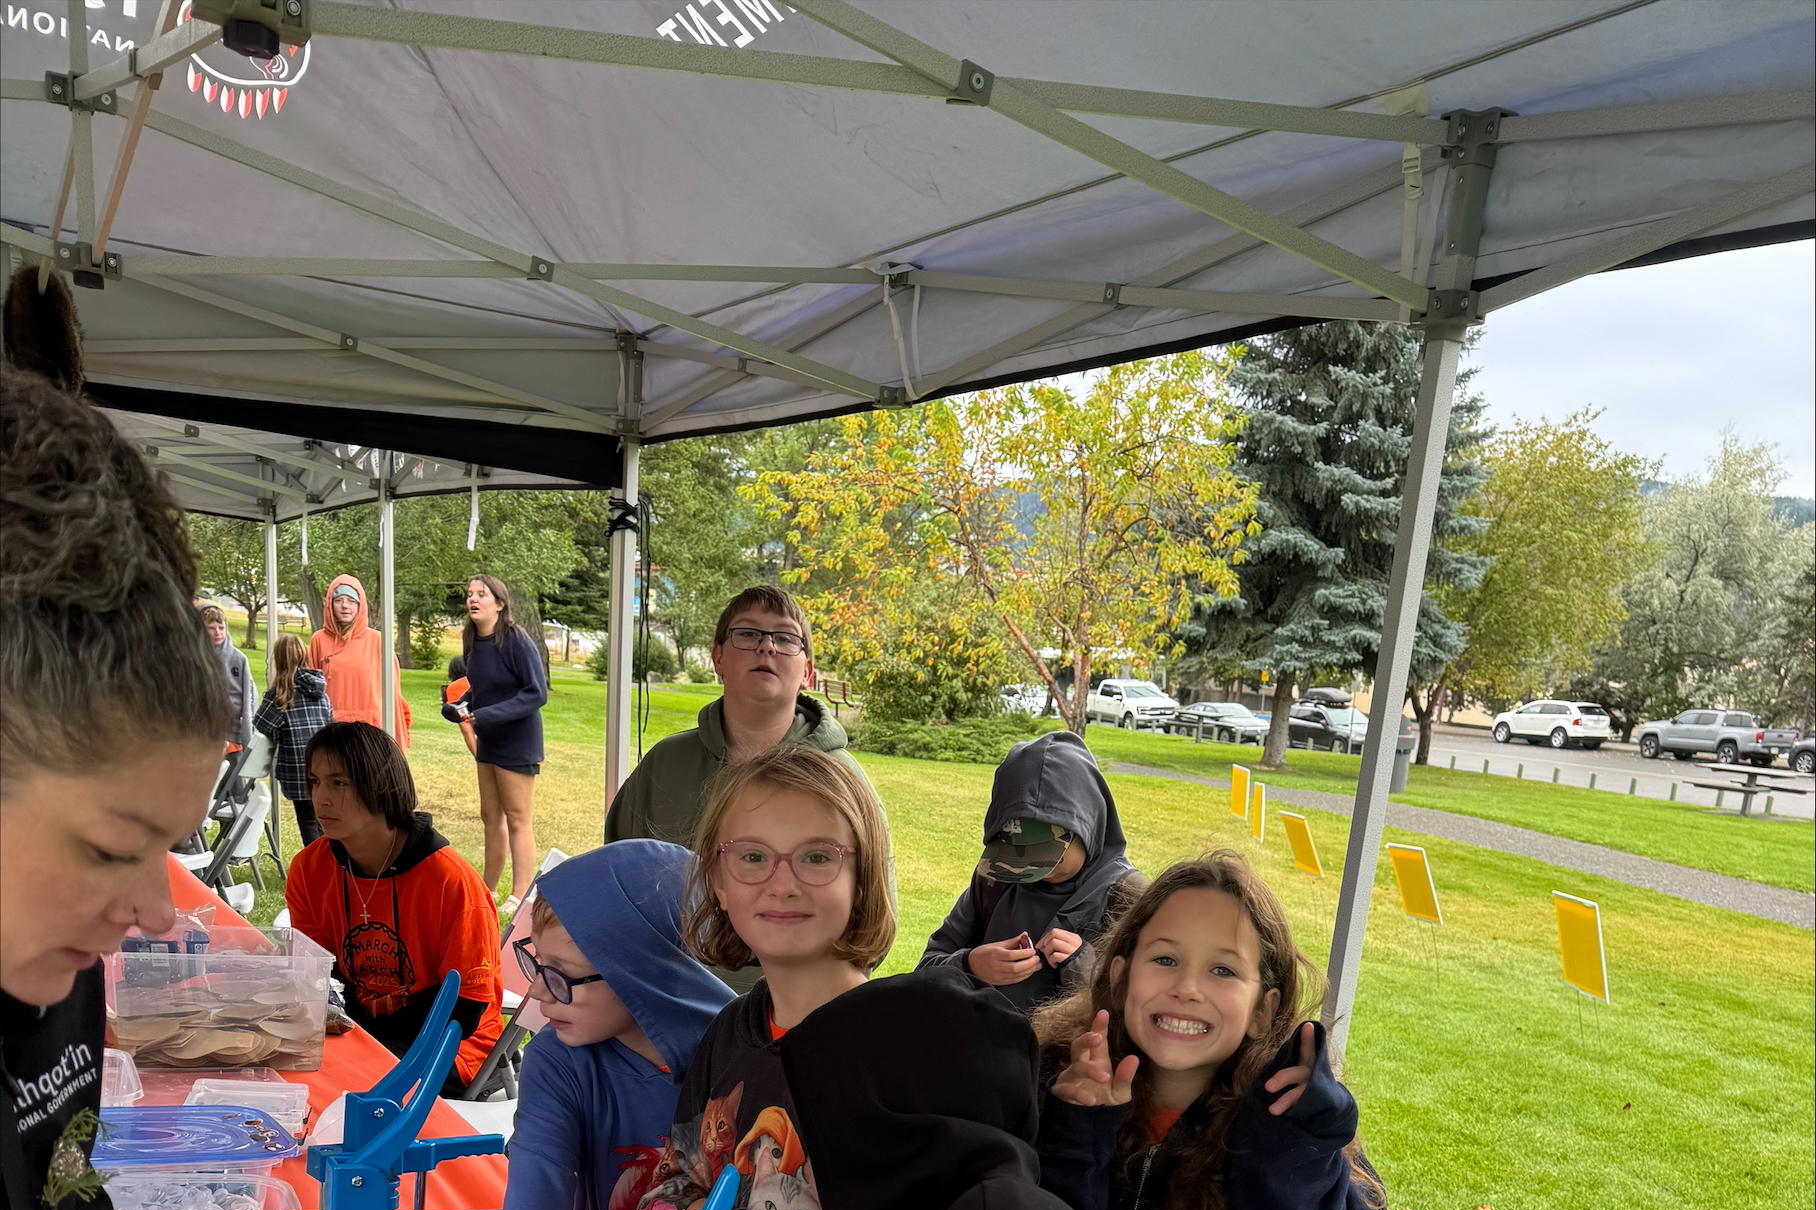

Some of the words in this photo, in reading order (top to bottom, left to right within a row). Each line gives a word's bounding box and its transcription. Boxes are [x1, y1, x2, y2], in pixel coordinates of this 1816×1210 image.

[351, 938, 399, 960] MARCH
[365, 954, 386, 964] with
[359, 963, 399, 977] ARCH
[368, 973, 399, 988] 2025
[46, 1067, 97, 1114] GOVERNMENT
